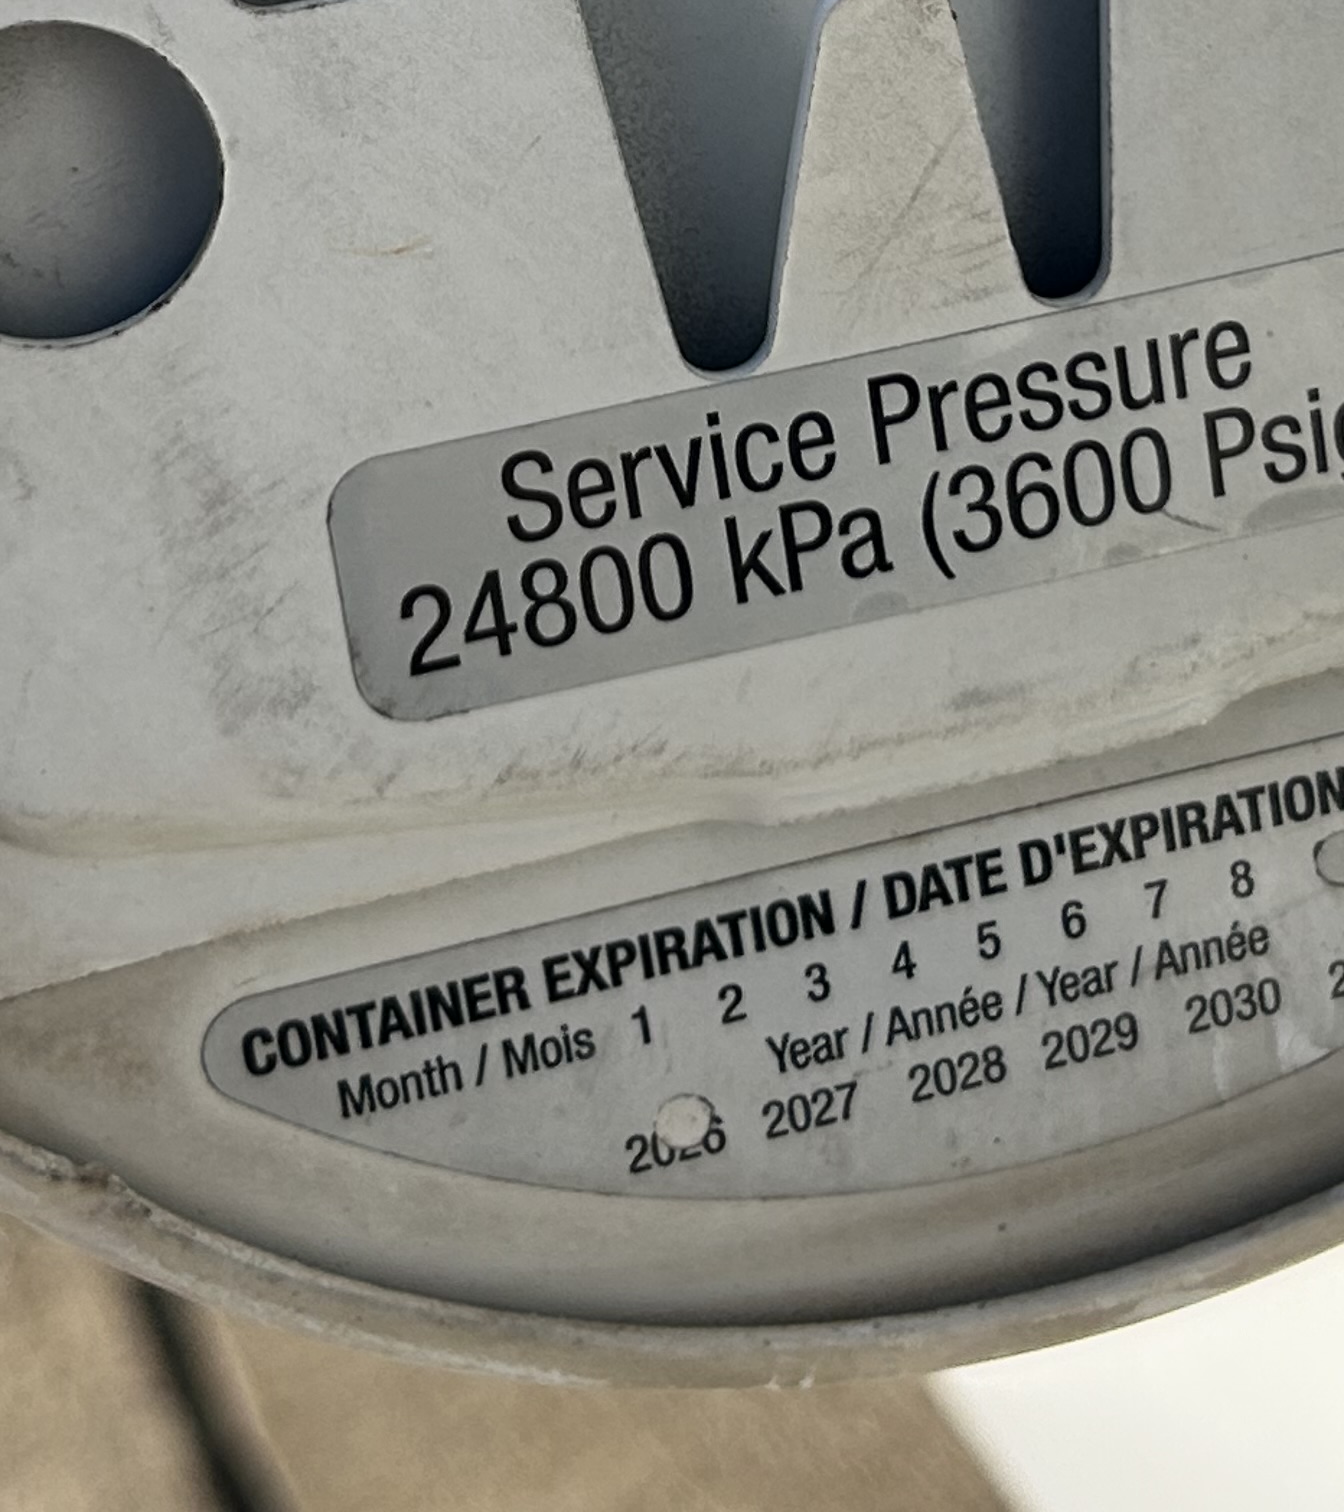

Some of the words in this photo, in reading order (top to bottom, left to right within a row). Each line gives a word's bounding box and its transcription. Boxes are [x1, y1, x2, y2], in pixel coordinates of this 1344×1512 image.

[501, 411, 836, 543] Service
[868, 321, 1251, 465] Pressure
[400, 533, 693, 678] 24800
[724, 500, 894, 605] kPa
[922, 427, 1172, 580] (3600
[241, 967, 530, 1078] CONTAINER
[542, 889, 835, 1000] EXPIRATION
[850, 879, 867, 930] /
[883, 848, 1008, 920] DATE
[337, 1055, 464, 1120] Month
[476, 1043, 488, 1087] /
[502, 1024, 596, 1079] Mois
[631, 1005, 651, 1045] 1
[718, 984, 747, 1025] 2
[805, 963, 831, 1003] 3
[892, 941, 917, 980] 4
[977, 920, 1001, 960] 5
[1061, 900, 1087, 940] 6
[1144, 879, 1167, 919] 7
[1231, 860, 1254, 898] 8
[765, 1027, 849, 1074] Year
[862, 1012, 874, 1054] /
[886, 986, 1003, 1047] Année
[1016, 973, 1027, 1016] /
[1035, 961, 1118, 1007] Year
[1131, 945, 1142, 987] /
[1155, 921, 1270, 981] Année
[625, 1114, 726, 1175] 206
[762, 1080, 857, 1140] 2027
[908, 1045, 1007, 1103] 2028
[1041, 1012, 1138, 1070] 2029
[1186, 978, 1281, 1034] 2030
